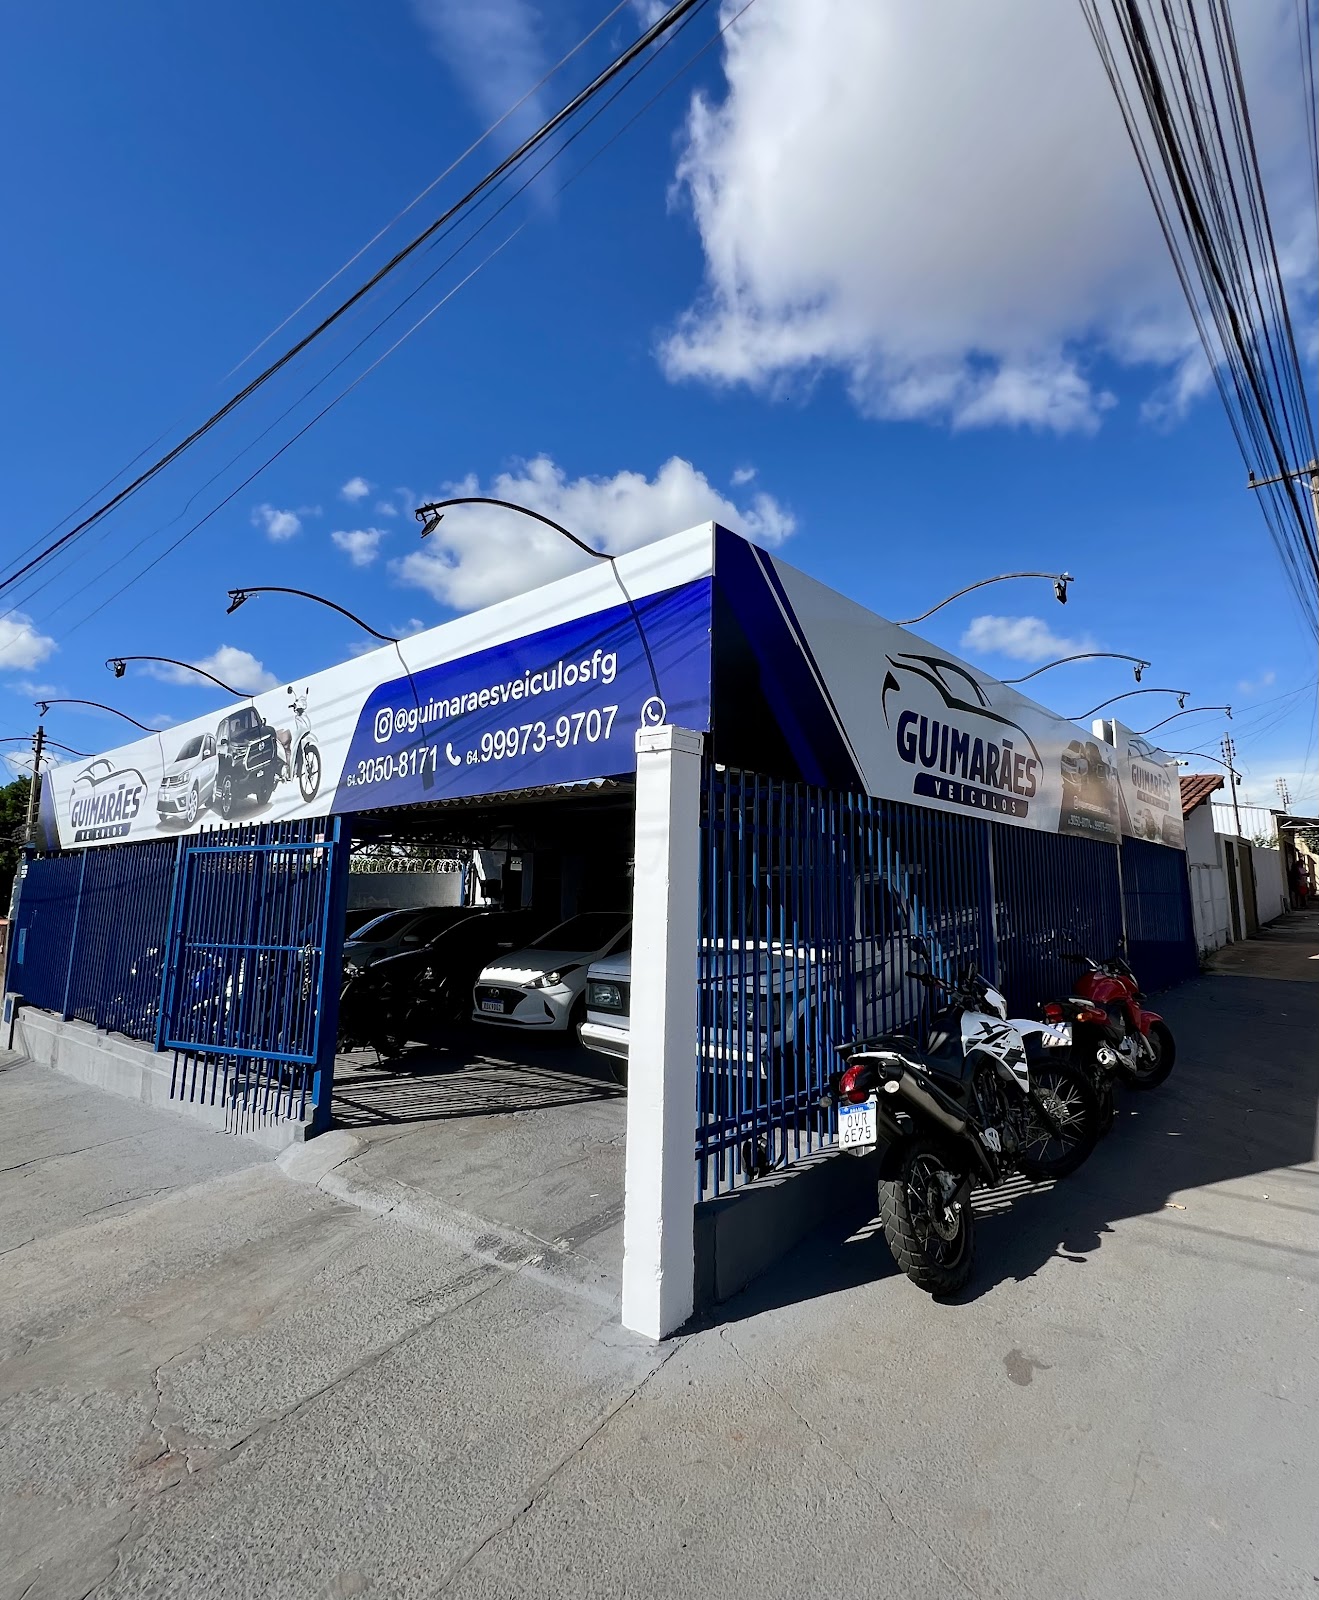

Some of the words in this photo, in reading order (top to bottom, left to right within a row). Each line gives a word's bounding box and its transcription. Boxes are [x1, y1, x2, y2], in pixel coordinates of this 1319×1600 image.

[394, 648, 618, 734] @guimaraesveiculosfg
[896, 709, 1038, 799] GUIMARÃES
[71, 783, 143, 828] GUIMARÃES
[934, 780, 1017, 814] VEÍCULOS
[81, 826, 123, 841] VECULOS
[844, 1125, 871, 1143] 6E75
